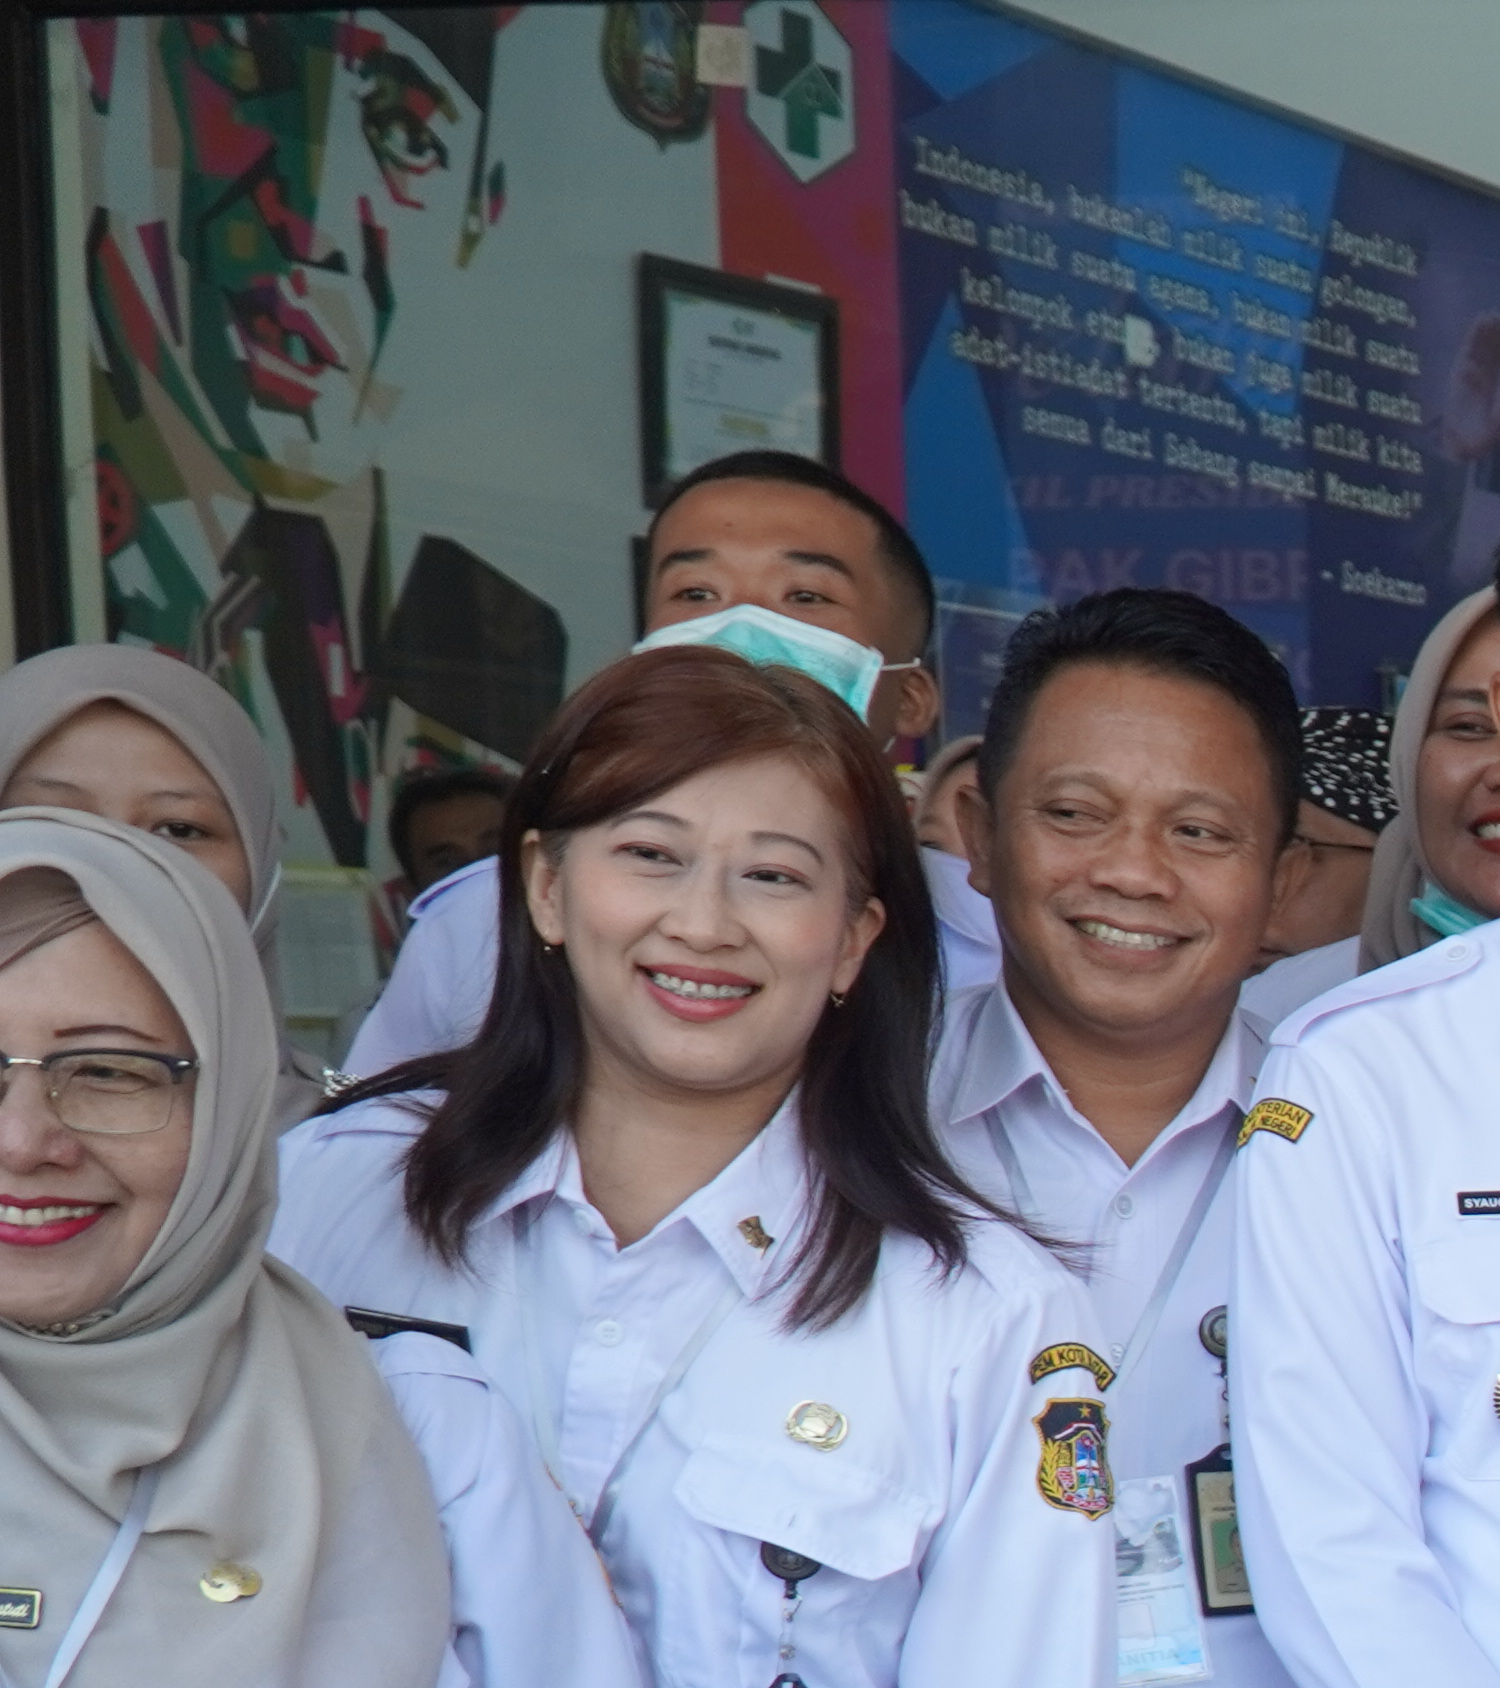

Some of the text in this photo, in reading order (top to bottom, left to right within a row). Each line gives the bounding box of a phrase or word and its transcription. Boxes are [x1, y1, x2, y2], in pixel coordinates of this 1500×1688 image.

[901, 188, 979, 248] bukan
[987, 223, 1060, 271] milik
[1071, 251, 1138, 292] suatu
[1231, 289, 1293, 339] bukan
[1300, 317, 1358, 358] milik
[1364, 339, 1421, 376] suatu
[913, 135, 1417, 328] Indonesia, bukanlah milik suatu golongan,
[1330, 218, 1418, 277] Republik
[952, 325, 1424, 476] adat-istiadat tertentu, tapi milik kita
[961, 266, 1075, 332] kelompok
[1172, 327, 1235, 375] bukan
[1245, 352, 1294, 395] juga
[1301, 369, 1360, 410] milik
[1366, 389, 1423, 426] suatu
[1022, 406, 1093, 446] semua
[1103, 415, 1155, 460] dari
[1163, 432, 1240, 489] Sabang
[1248, 460, 1318, 503] sampai
[1340, 559, 1428, 608] Soekarno
[1119, 1648, 1181, 1667] ANITIA
